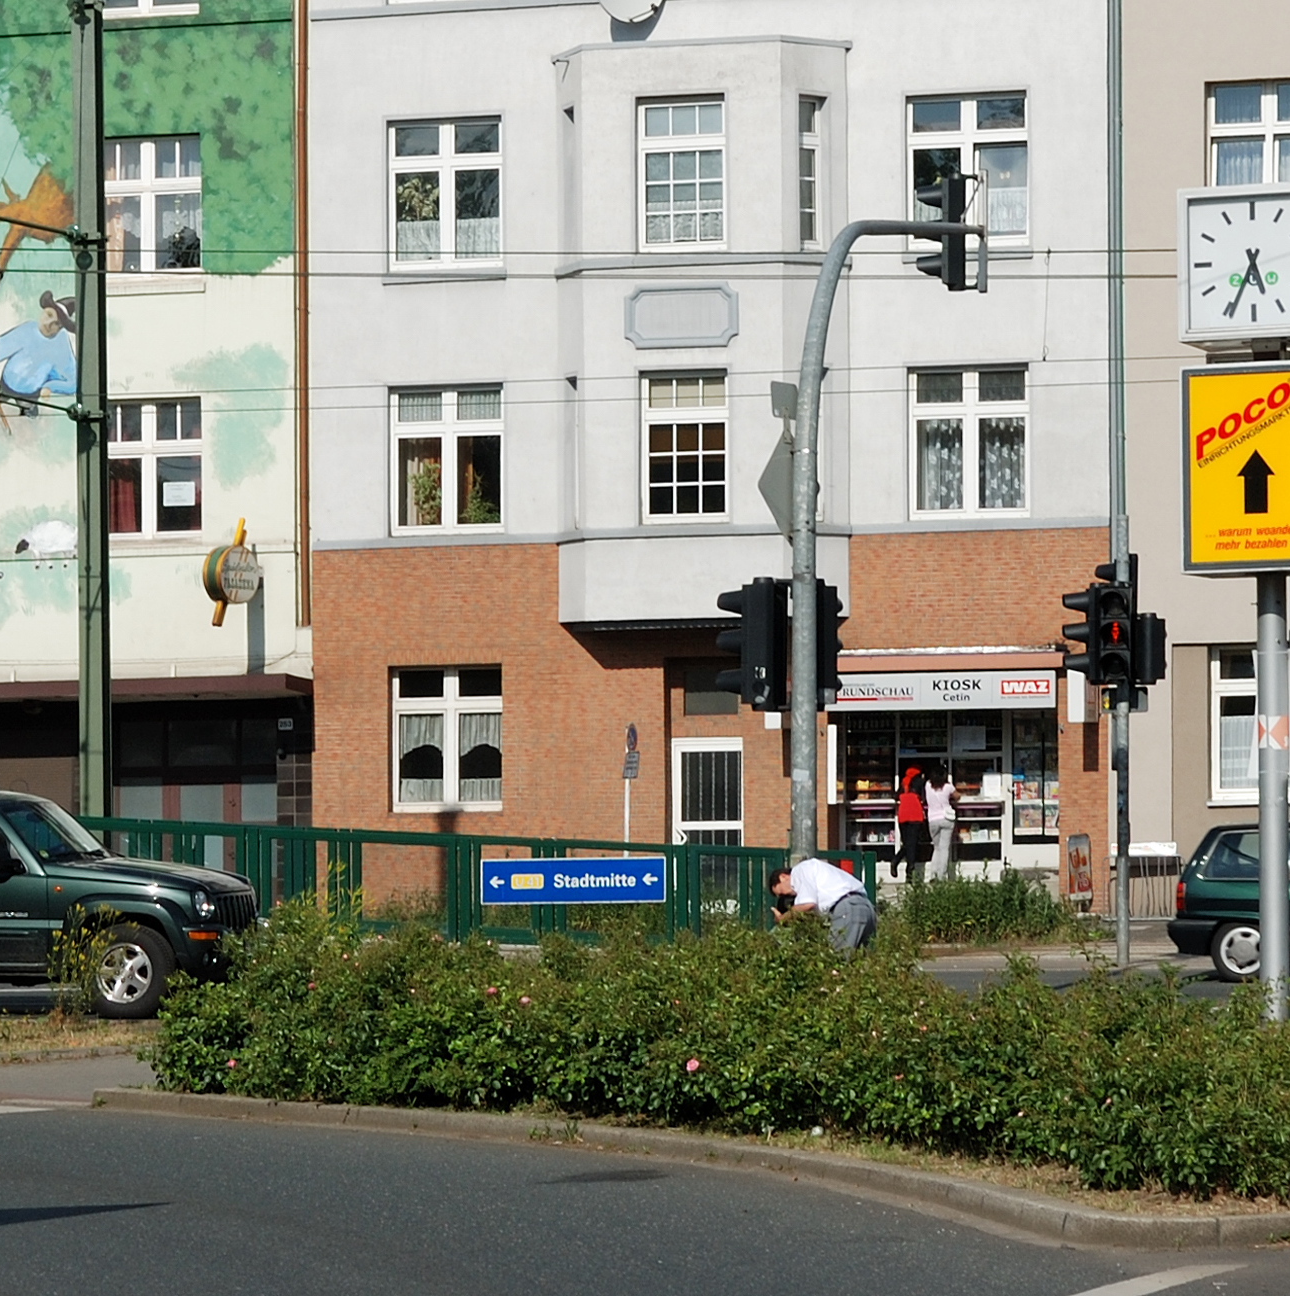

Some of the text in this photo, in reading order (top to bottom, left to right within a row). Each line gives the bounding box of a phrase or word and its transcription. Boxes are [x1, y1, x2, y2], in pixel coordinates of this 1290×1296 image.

[1196, 382, 1290, 461] POCO
[1219, 527, 1252, 537] warum
[1215, 540, 1241, 550] mehr
[1245, 538, 1288, 549] bezahlen
[932, 679, 981, 691] KIOSK
[1002, 681, 1049, 693] WAZ
[942, 693, 970, 702] Cetin
[553, 873, 637, 888] Stadtmitte
